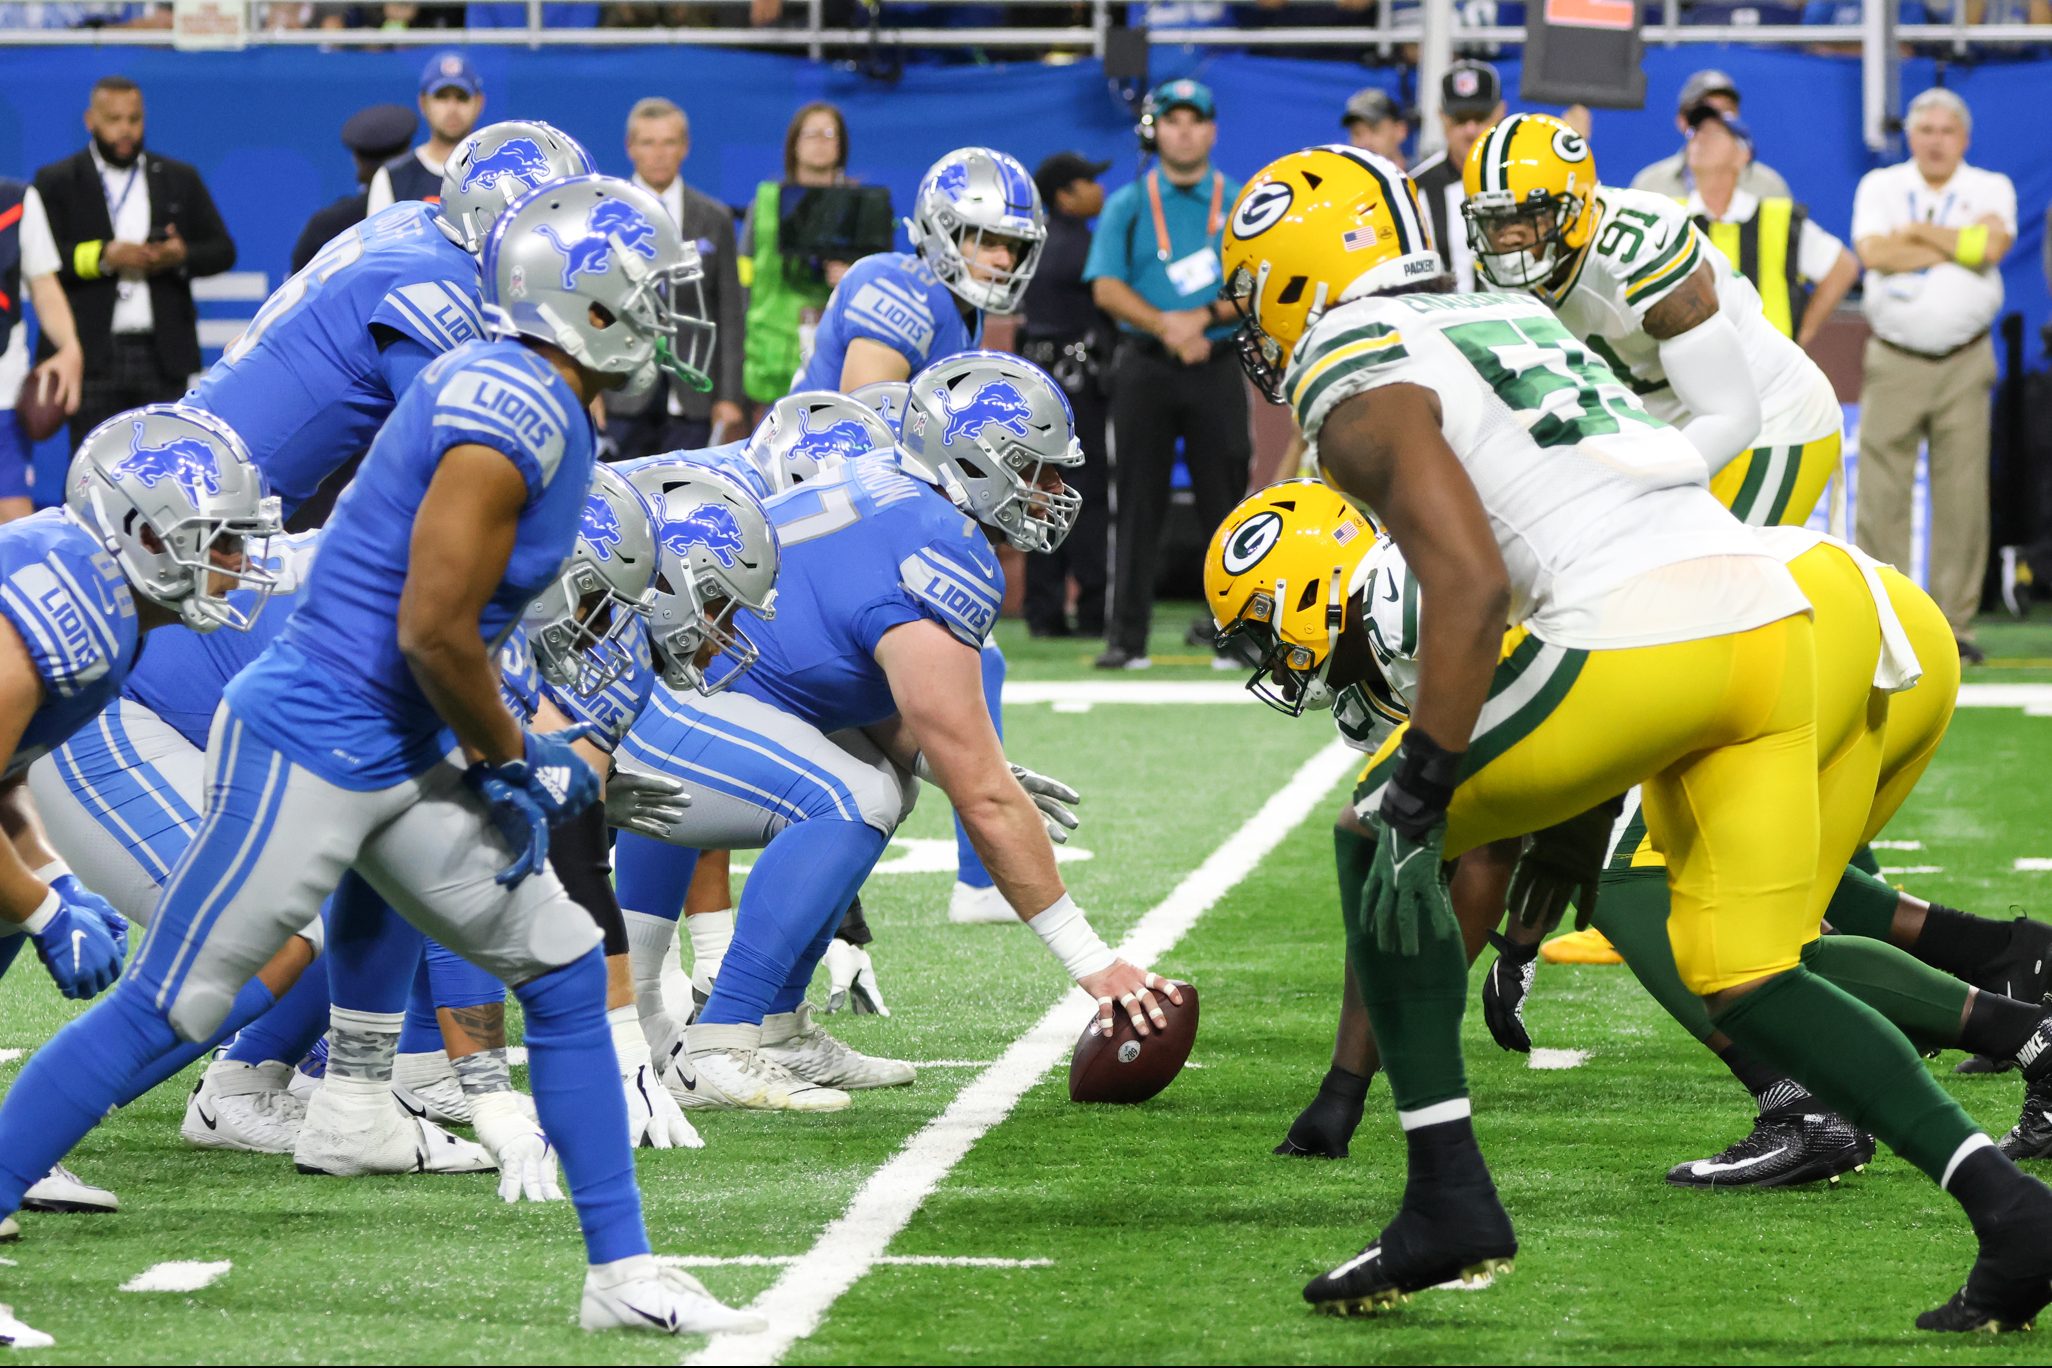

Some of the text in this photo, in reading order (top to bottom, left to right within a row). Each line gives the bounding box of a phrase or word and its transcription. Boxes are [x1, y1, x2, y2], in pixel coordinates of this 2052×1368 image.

[1231, 181, 1294, 241] G
[1597, 207, 1660, 264] 91
[873, 297, 928, 343] LIONS
[472, 380, 554, 449] LIONS
[1223, 511, 1283, 577] G
[39, 586, 100, 668] LIONS
[924, 576, 991, 630] LIONS
[1125, 1047, 1138, 1061] 289
[2015, 1030, 2050, 1069] NIKE
